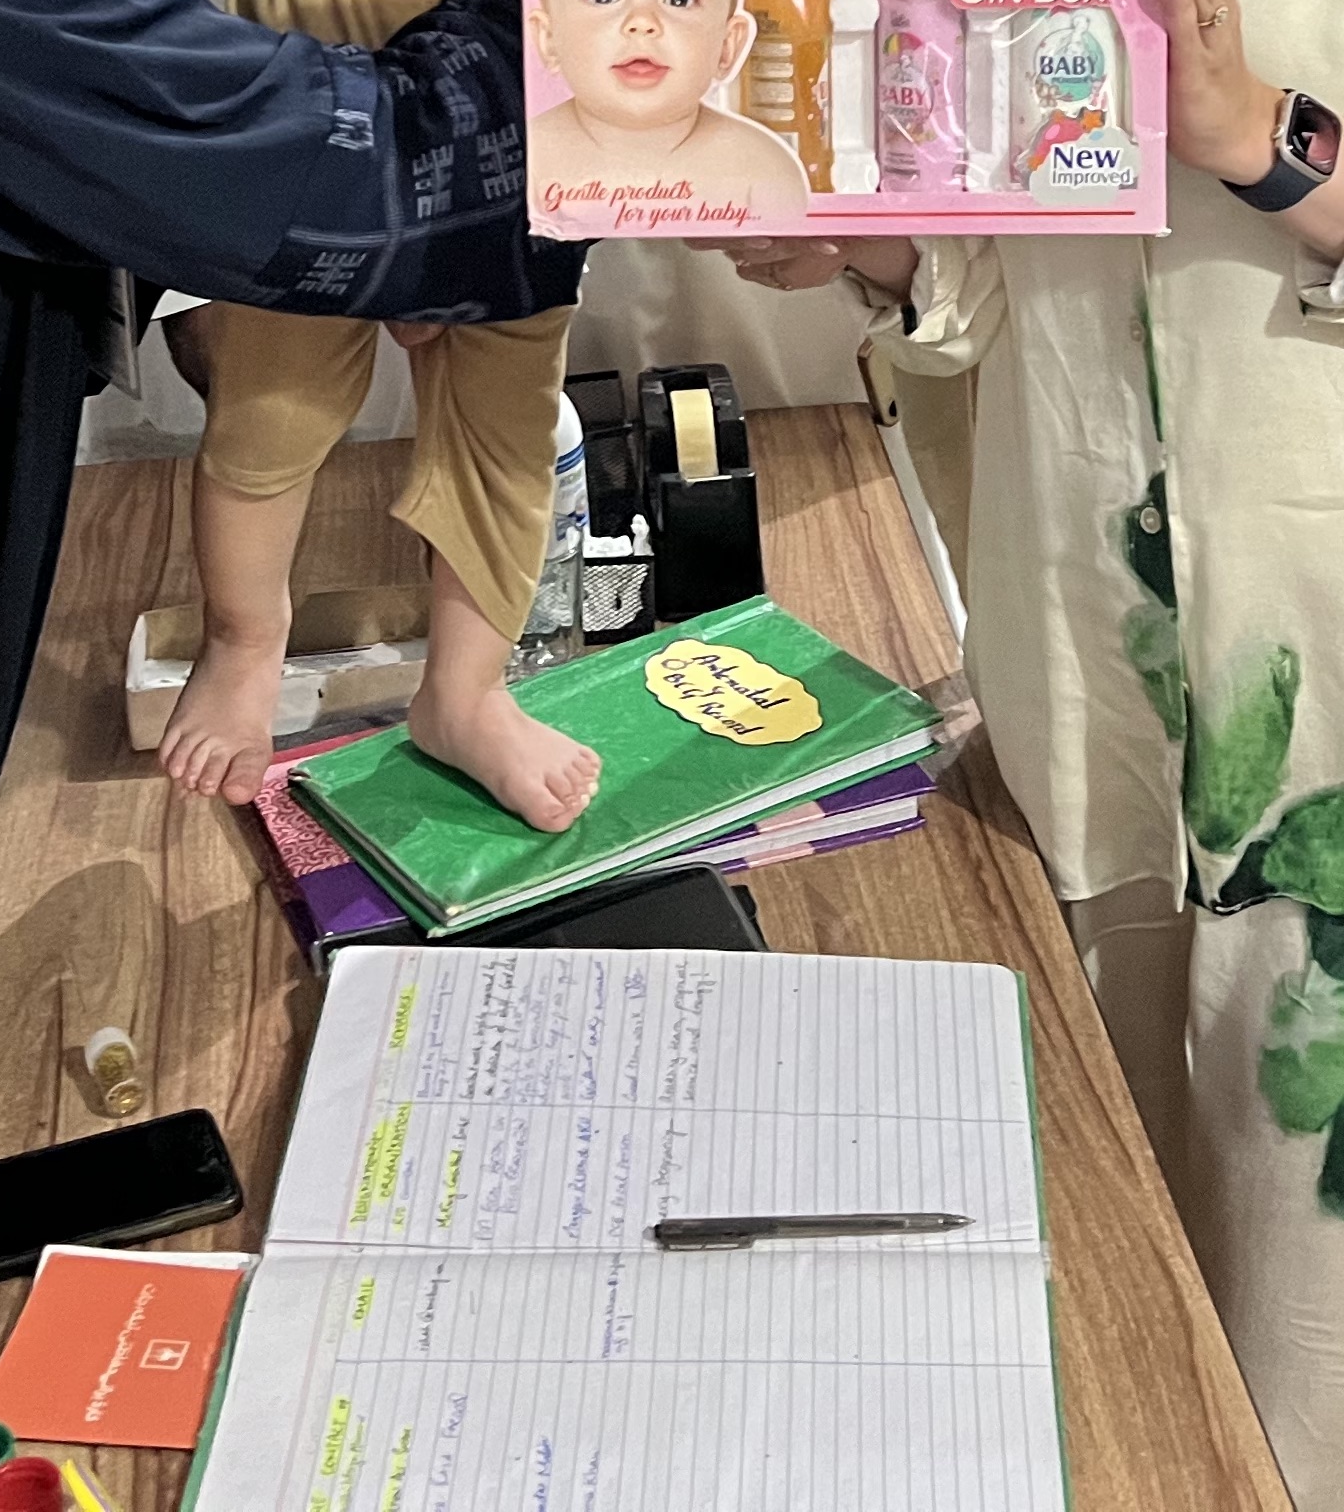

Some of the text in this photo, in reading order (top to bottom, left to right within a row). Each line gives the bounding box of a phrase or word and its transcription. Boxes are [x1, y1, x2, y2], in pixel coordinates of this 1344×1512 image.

[1040, 55, 1099, 76] BABY
[1052, 146, 1121, 169] New
[1052, 168, 1131, 187] Improved
[544, 179, 695, 212] Gentle products
[613, 200, 762, 230] for your baby...
